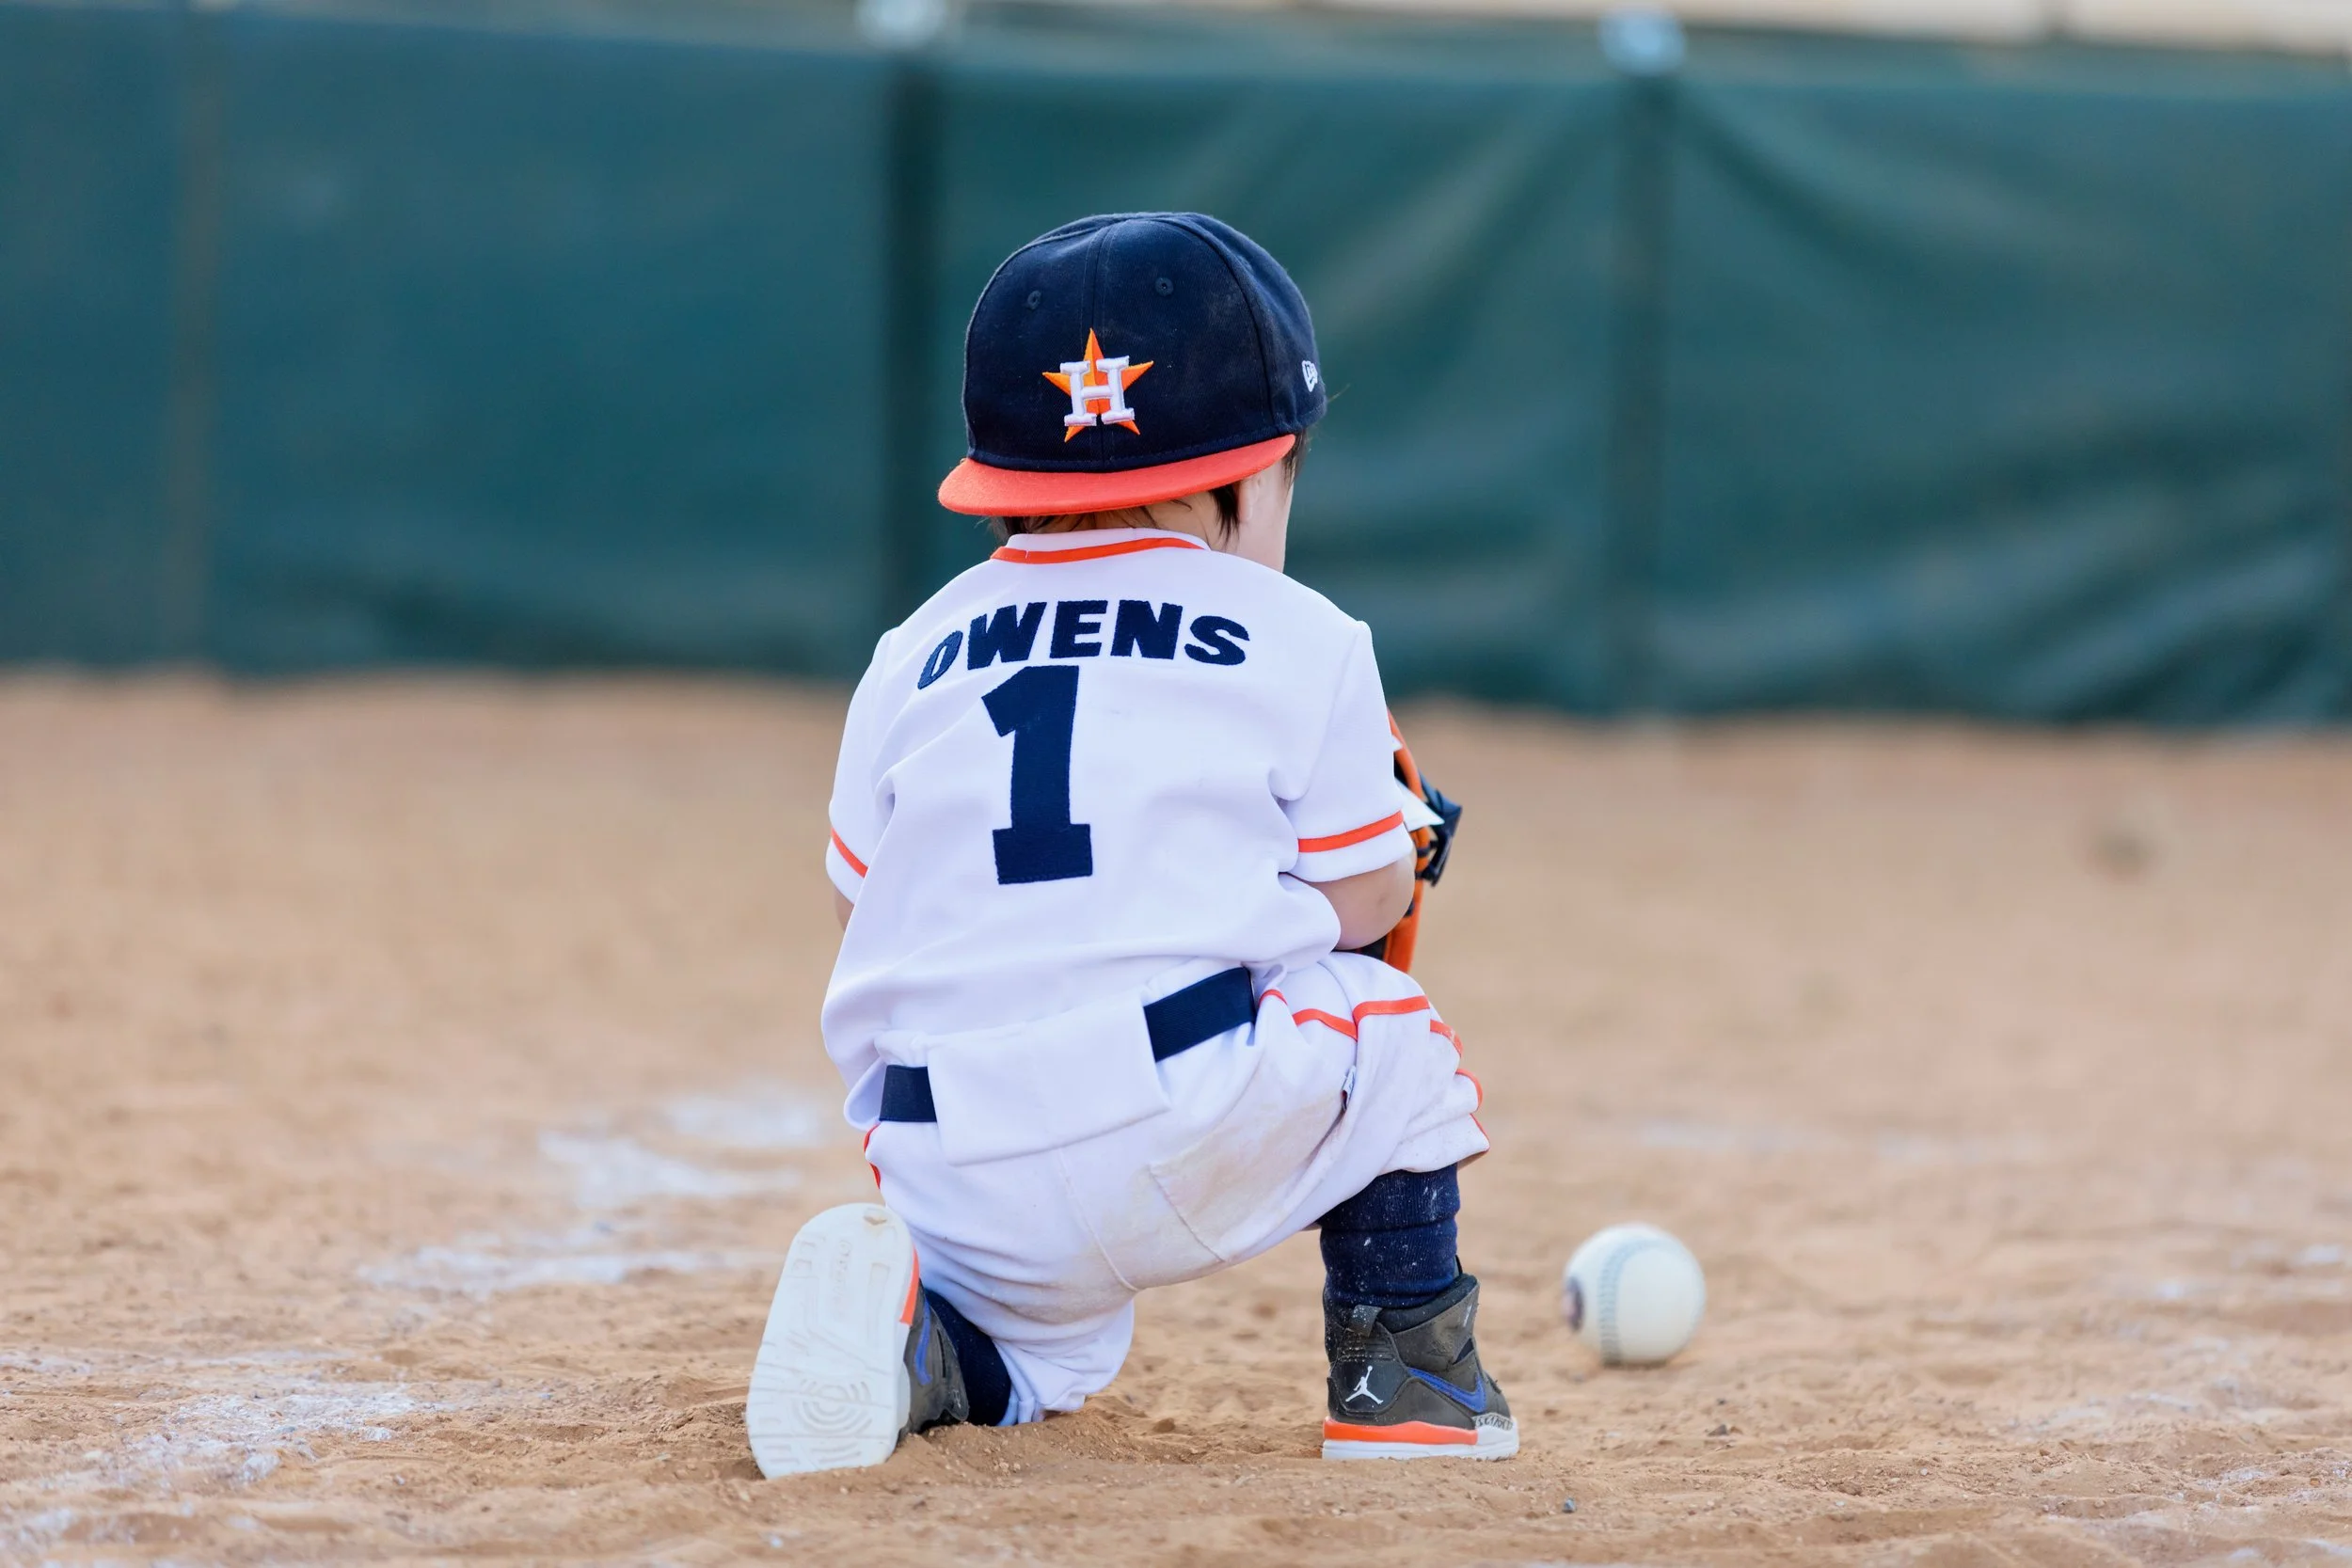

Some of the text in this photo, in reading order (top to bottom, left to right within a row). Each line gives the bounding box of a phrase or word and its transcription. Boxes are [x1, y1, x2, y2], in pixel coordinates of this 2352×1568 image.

[1059, 356, 1135, 426] H
[917, 599, 1250, 690] OWENS
[981, 665, 1093, 885] 1
